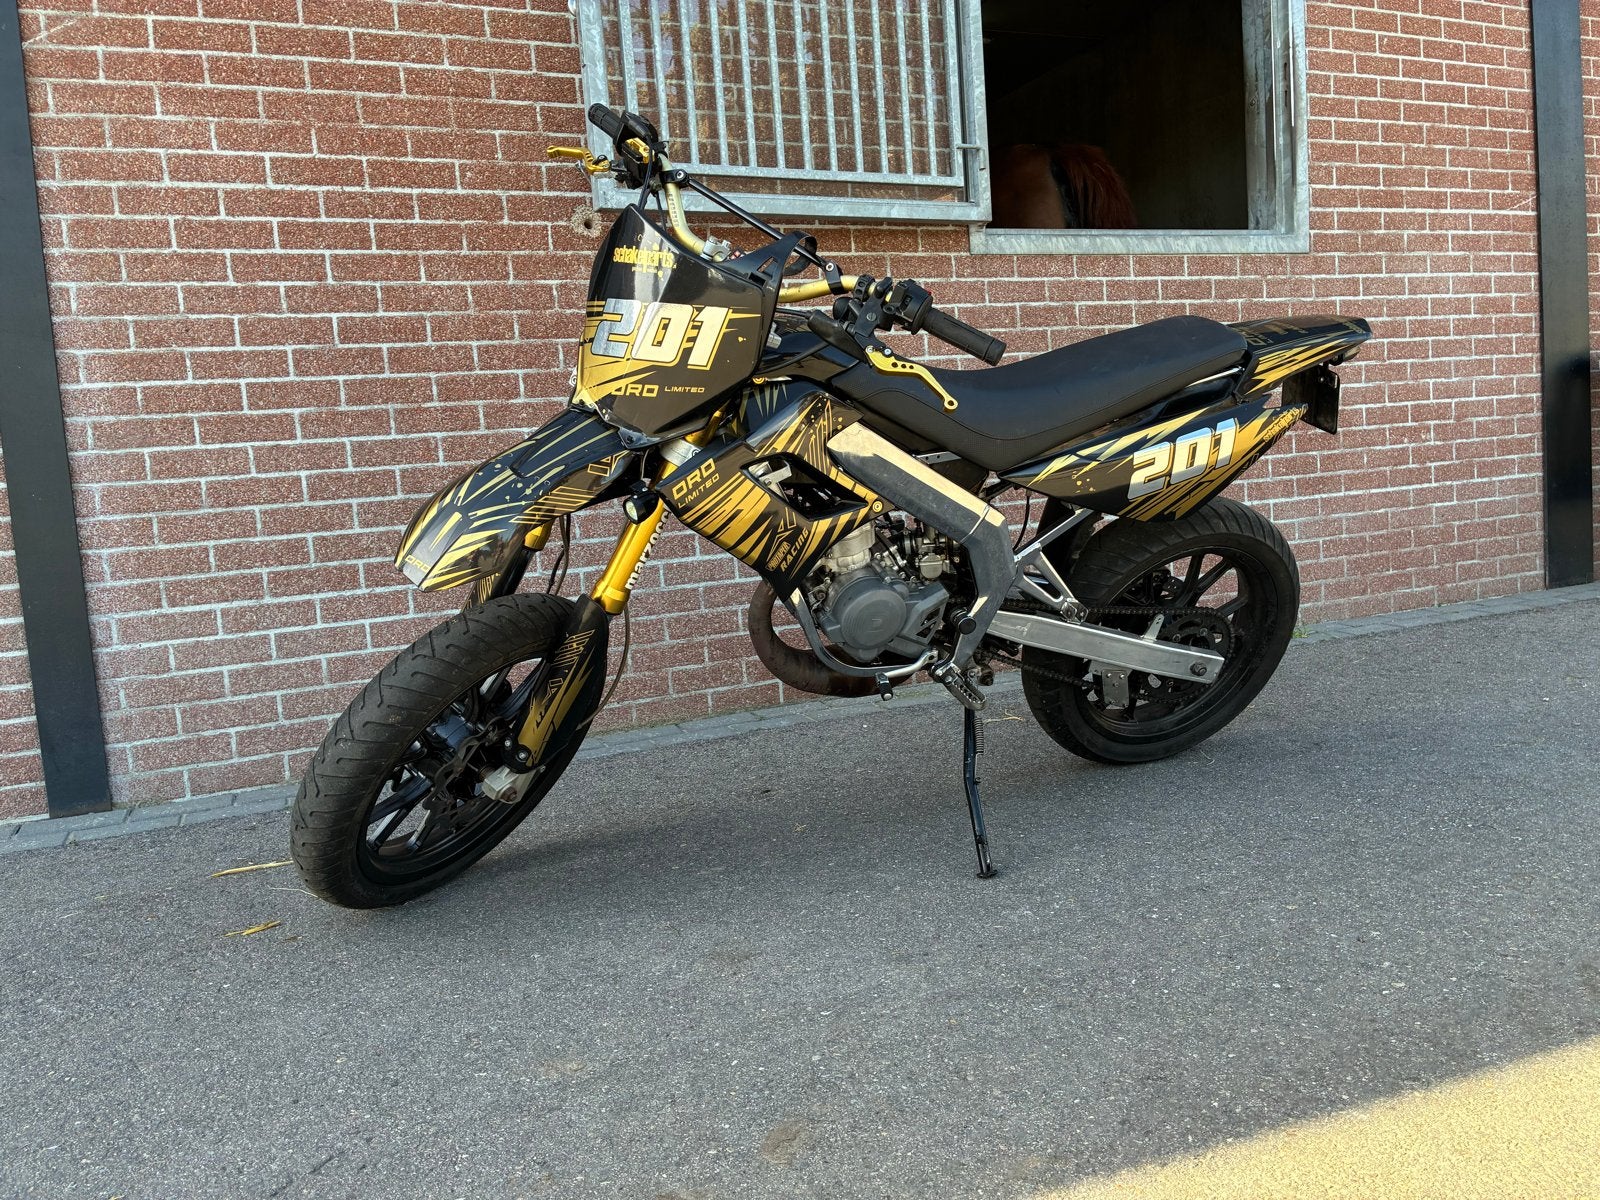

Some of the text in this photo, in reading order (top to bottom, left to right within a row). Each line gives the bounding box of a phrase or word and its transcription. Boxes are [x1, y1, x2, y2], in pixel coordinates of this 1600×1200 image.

[591, 298, 731, 370] 201
[664, 385, 705, 393] LIMITED
[672, 457, 716, 500] ORO
[1127, 417, 1239, 502] 201
[677, 473, 720, 509] LIMITED
[780, 527, 810, 572] RACING
